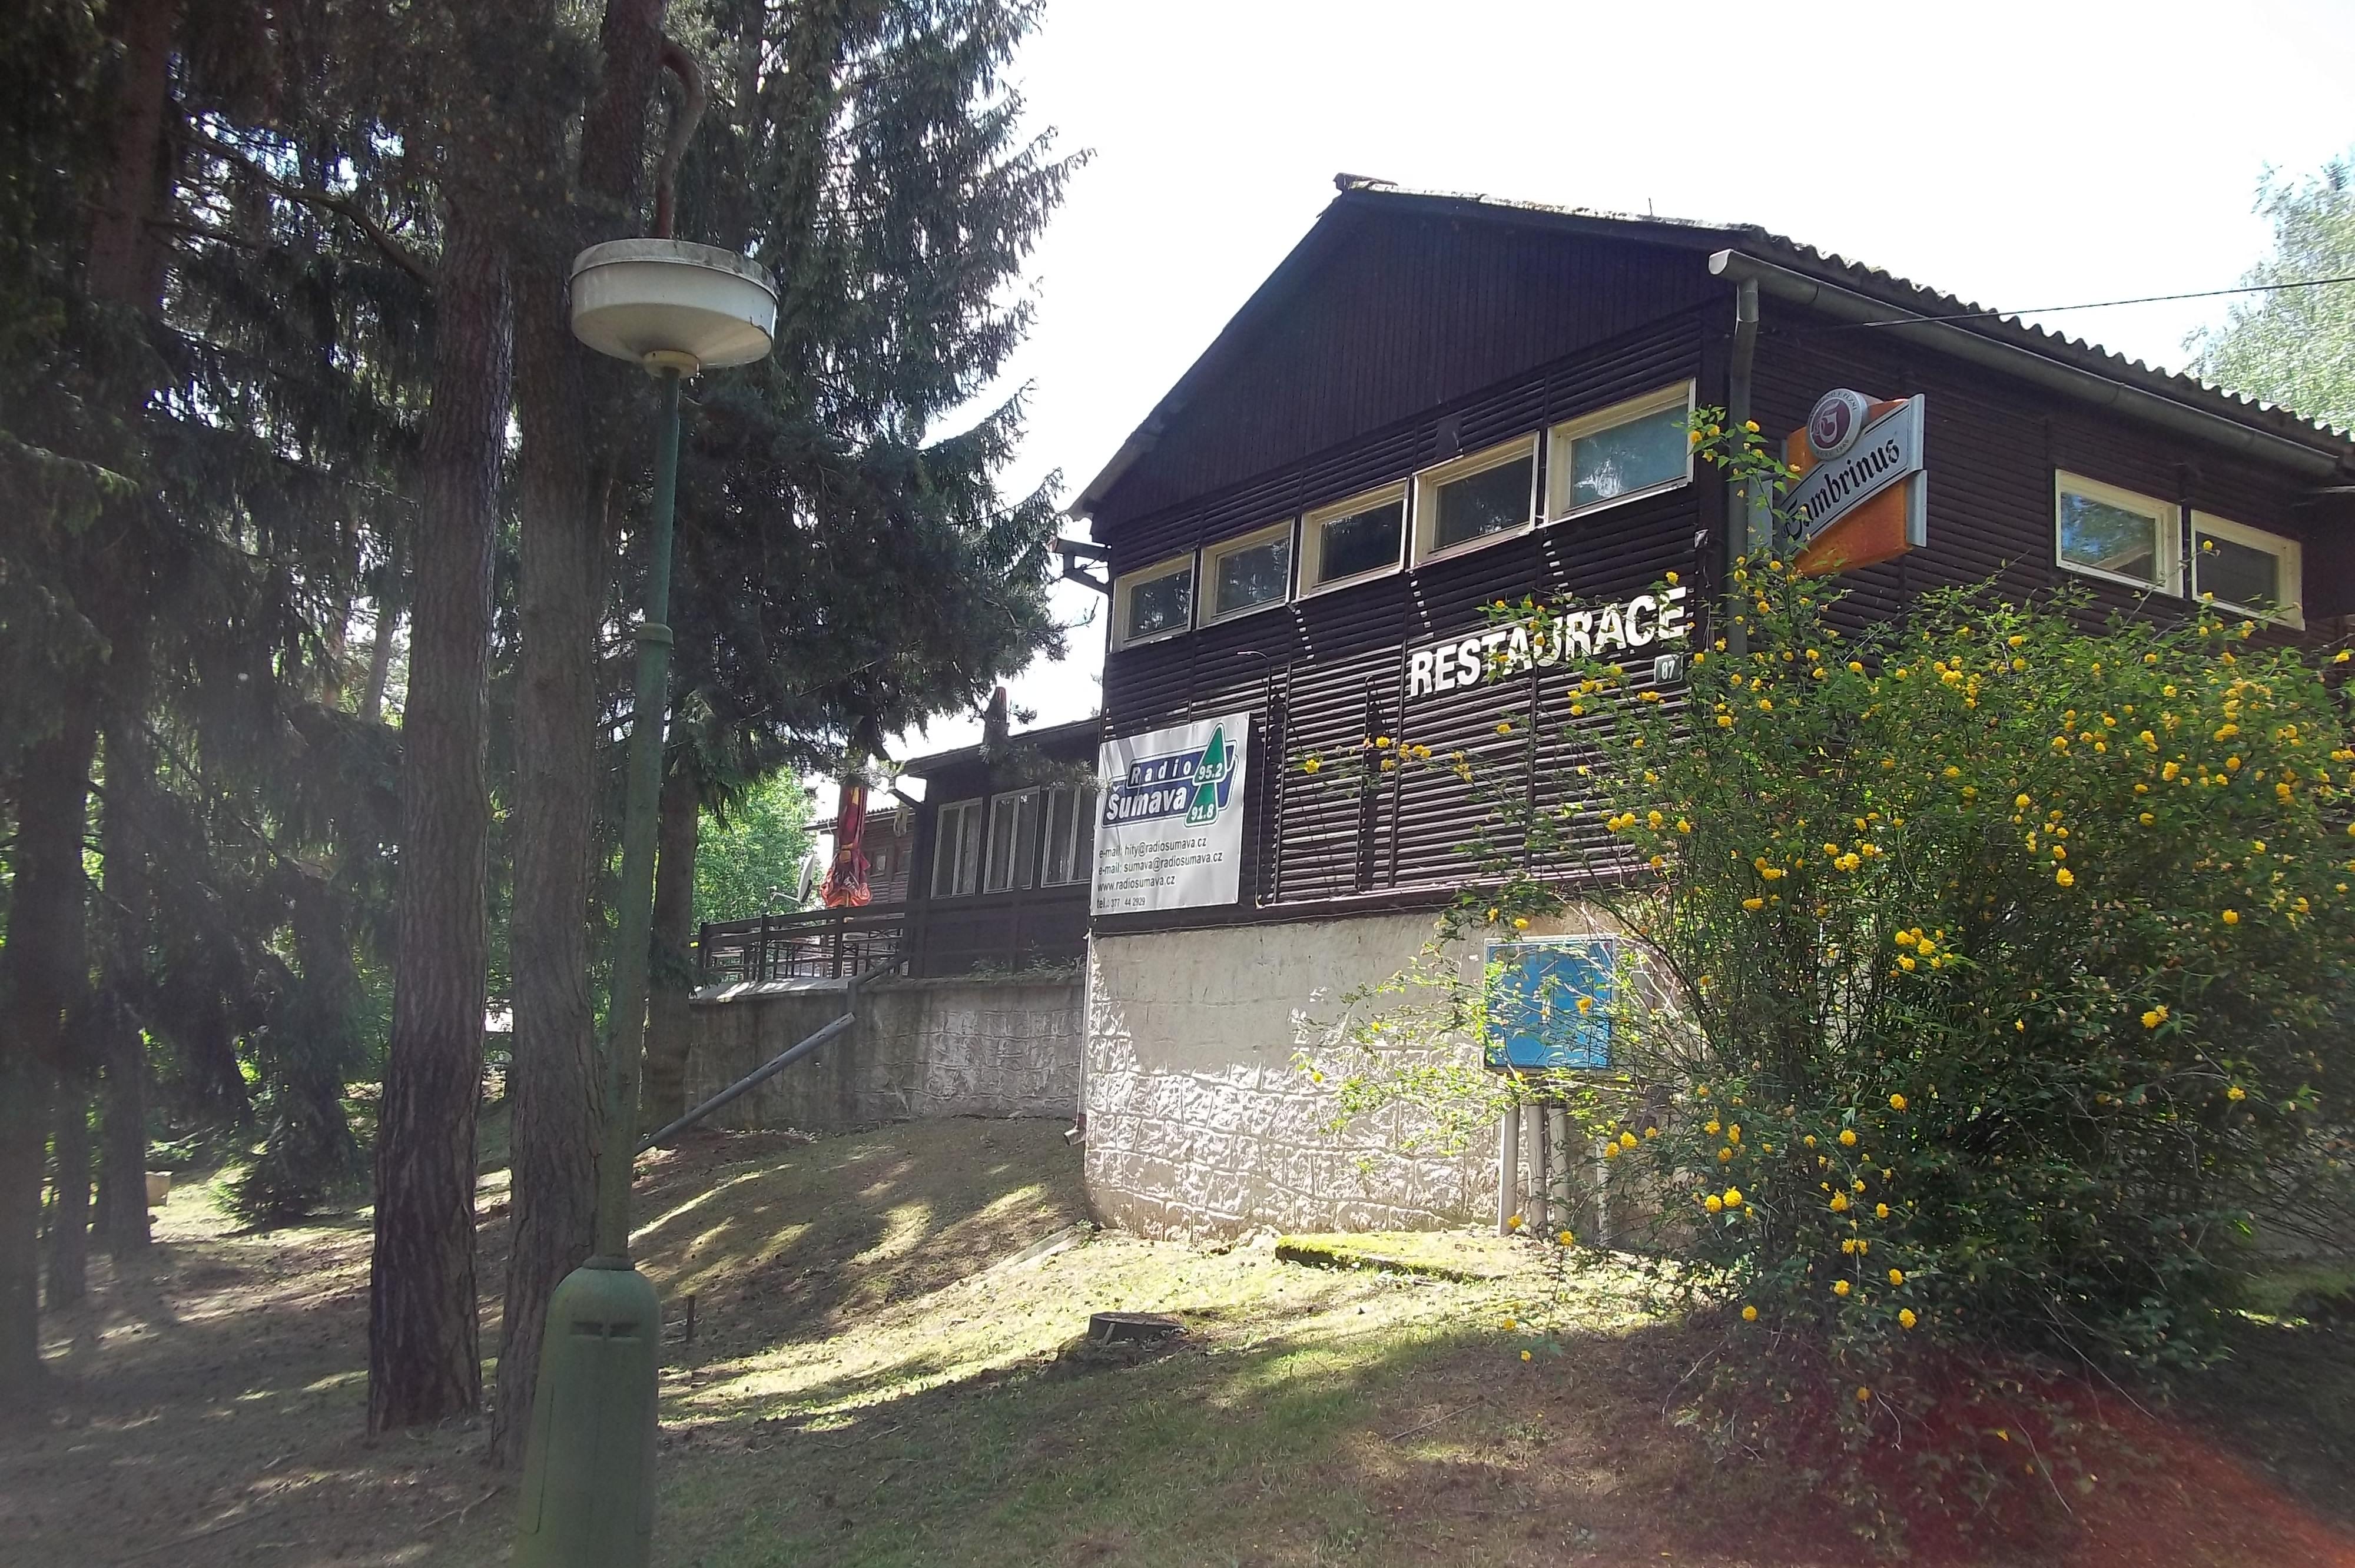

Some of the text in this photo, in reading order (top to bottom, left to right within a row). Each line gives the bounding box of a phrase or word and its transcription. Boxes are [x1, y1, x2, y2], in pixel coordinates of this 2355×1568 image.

[1410, 586, 1686, 697] RESTAURACE
[1661, 660, 1676, 680] 87
[1130, 760, 1191, 784] Radio
[1199, 762, 1222, 779] 95.2
[1106, 785, 1187, 821] Šumava
[1190, 803, 1214, 821] 91.8
[1099, 838, 1206, 858] e-mail: hity@radiosumava.cz
[1099, 852, 1223, 875] e-mail: sumava@radiosumava.cz
[1097, 875, 1175, 892] www.radiosumava.cz
